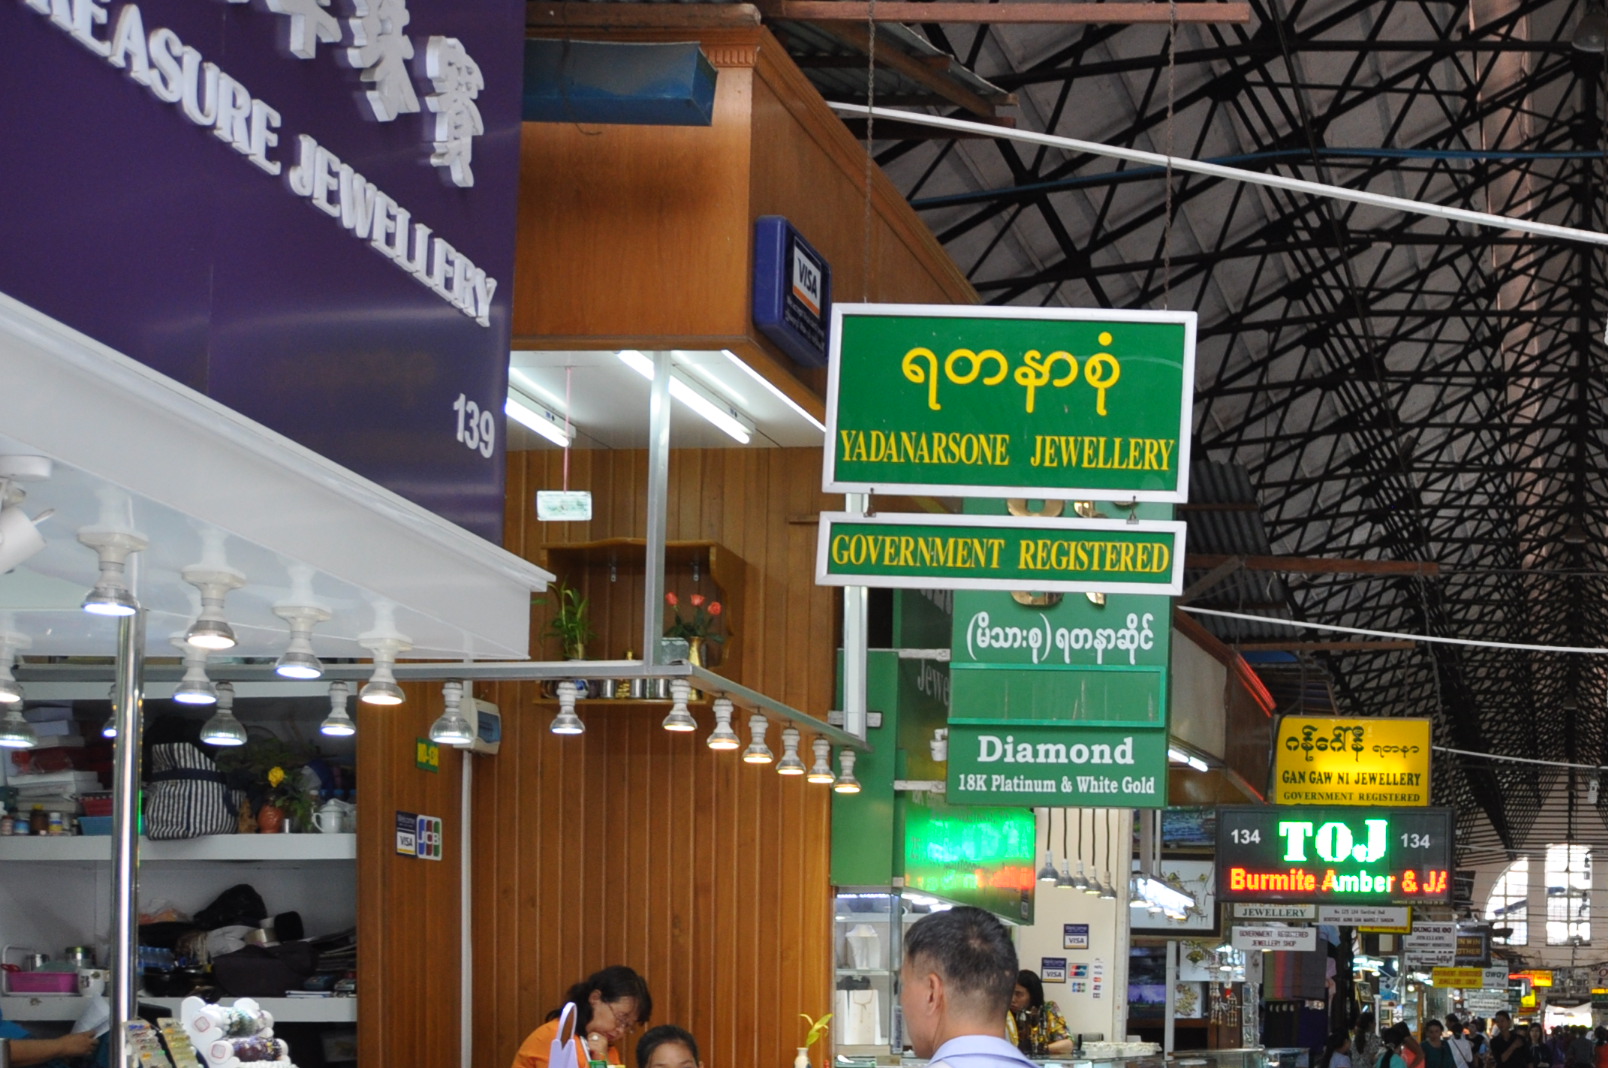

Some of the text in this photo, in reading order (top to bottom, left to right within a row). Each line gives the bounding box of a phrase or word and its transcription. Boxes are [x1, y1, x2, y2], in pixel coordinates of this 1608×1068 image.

[289, 134, 497, 328] JEWELLERY
[797, 257, 818, 299] VISA
[453, 392, 495, 459] 139
[840, 429, 1175, 472] YADANARSONE JEWELLERY
[832, 533, 1169, 574] GOVERNMENT REGISTERED
[977, 735, 1135, 765] Diamond
[958, 774, 1155, 794] 18K Platinum & White Gold
[1282, 770, 1421, 787] GAN GAW NI JEWELLERY
[1283, 791, 1421, 802] GOVERNMENT REGISTERED
[1230, 829, 1262, 844] 134
[1278, 819, 1388, 863] TOJ
[1400, 833, 1431, 849] 134
[1230, 868, 1317, 891] Burmite
[1320, 869, 1396, 893] Amber
[1401, 869, 1419, 893] &
[1242, 908, 1308, 918] JEWELLERY
[1068, 937, 1085, 945] VISA
[1251, 939, 1297, 948] JEWELLERY SHOP
[1046, 970, 1063, 978] VISA
